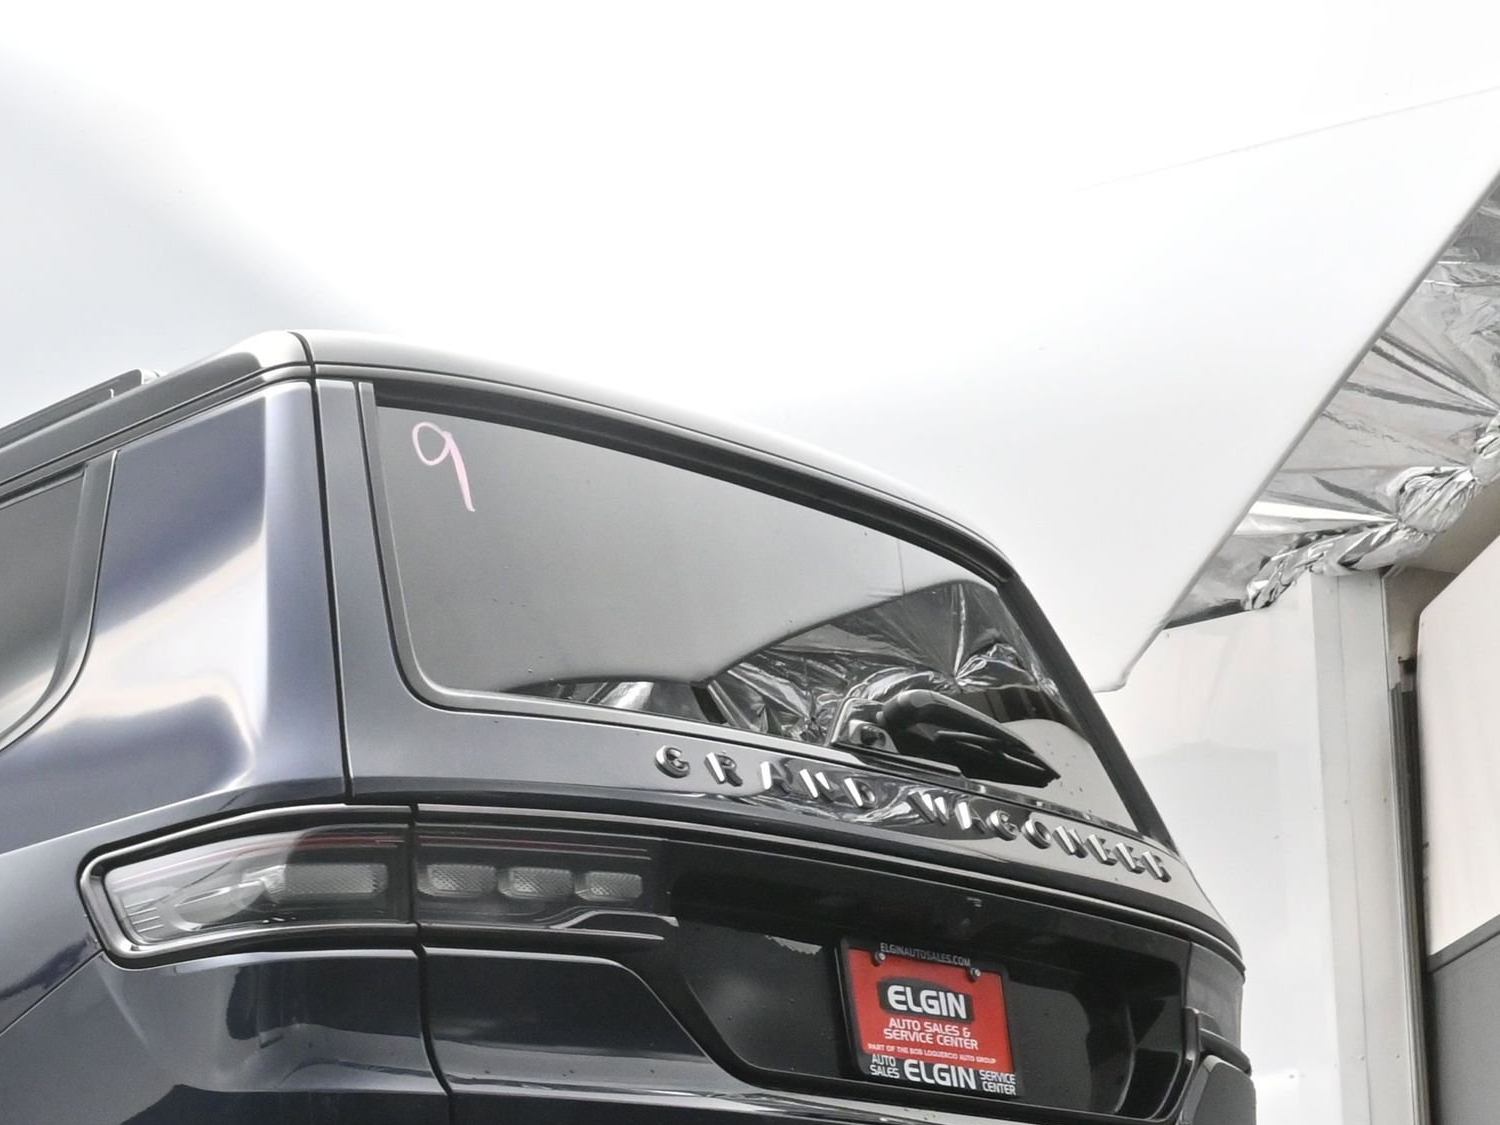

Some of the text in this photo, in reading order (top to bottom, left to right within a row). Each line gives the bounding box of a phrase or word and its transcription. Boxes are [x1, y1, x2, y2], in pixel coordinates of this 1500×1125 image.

[412, 421, 476, 512] 9
[655, 745, 1172, 883] GRAND WAGONEER
[880, 942, 972, 967] ELGINAUTOSALES.COM
[887, 984, 968, 1019] ELGIN
[888, 1018, 971, 1038] AUTO SALES &
[867, 1042, 885, 1051] PART
[883, 1028, 979, 1050] SERVICE CENTER
[871, 1053, 896, 1067] AUTO
[869, 1064, 900, 1079] SALES
[903, 1058, 977, 1090] ELGIN
[979, 1069, 1016, 1085] SERVICE
[982, 1080, 1017, 1096] CENTER
